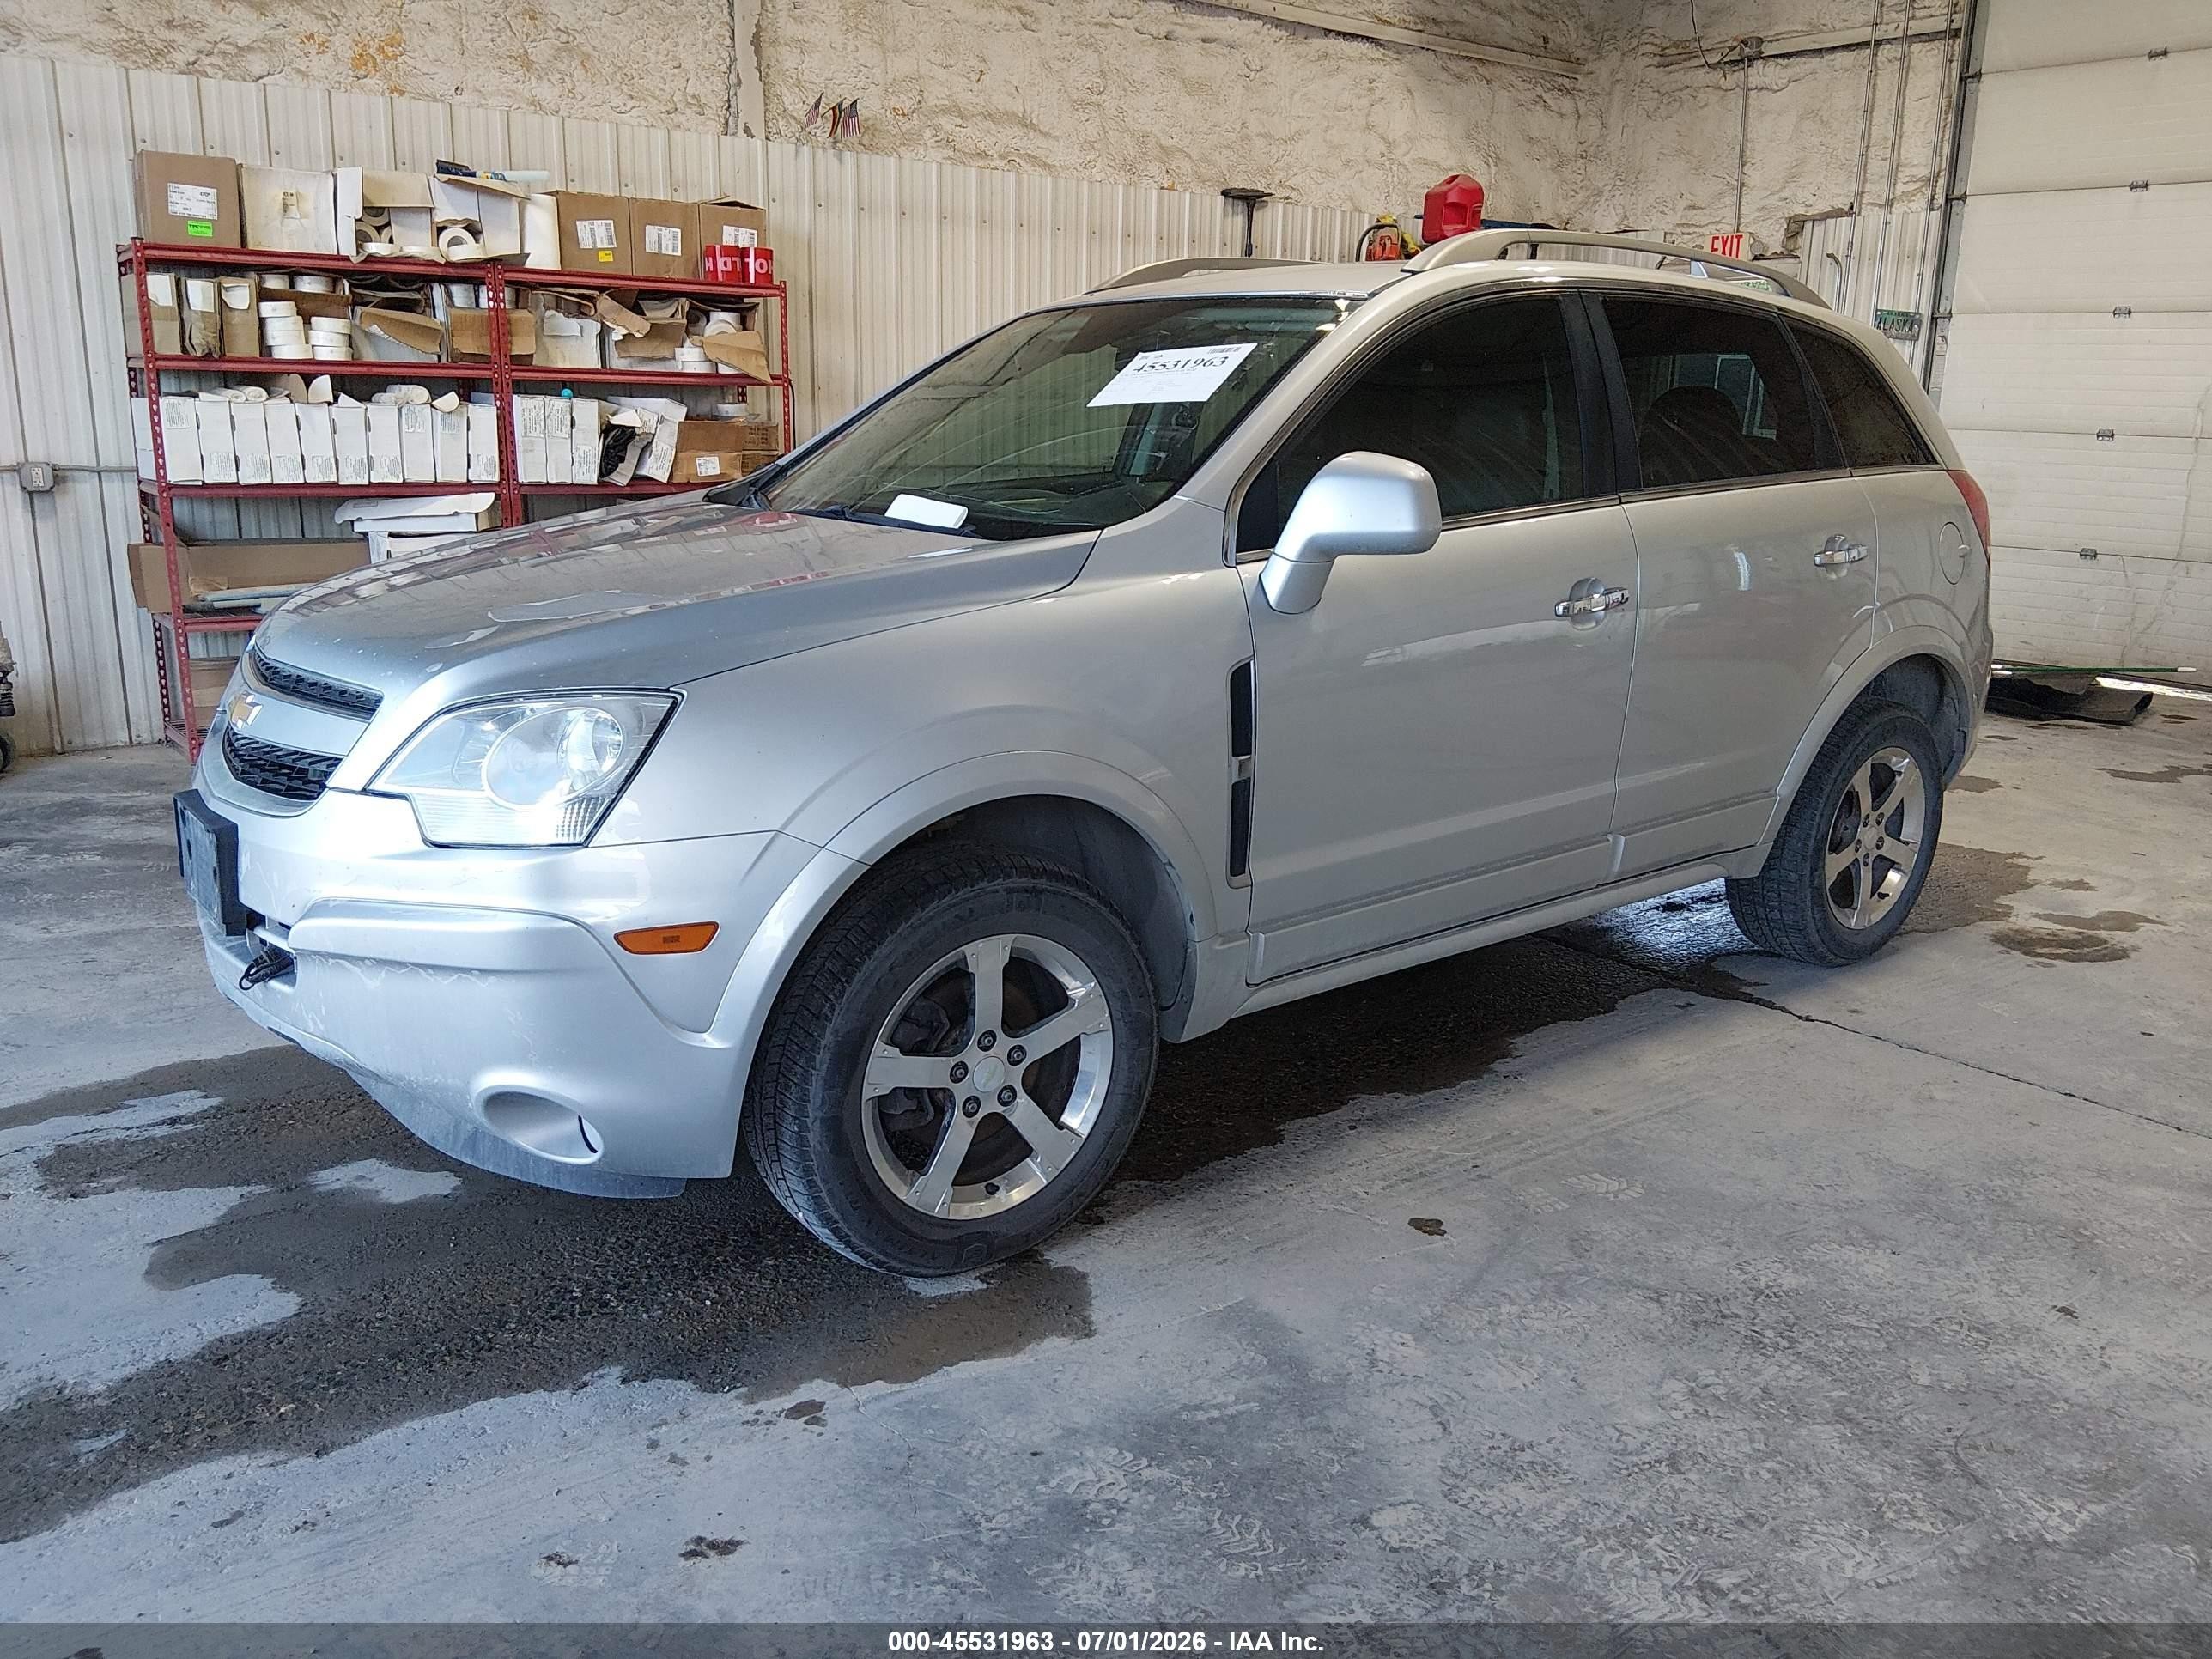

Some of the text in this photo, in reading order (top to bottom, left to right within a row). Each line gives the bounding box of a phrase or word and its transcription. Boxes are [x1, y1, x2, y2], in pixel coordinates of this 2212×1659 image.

[1711, 234, 1743, 259] EXIT
[1876, 316, 1914, 333] ALASKA
[1133, 356, 1229, 373] 45531963
